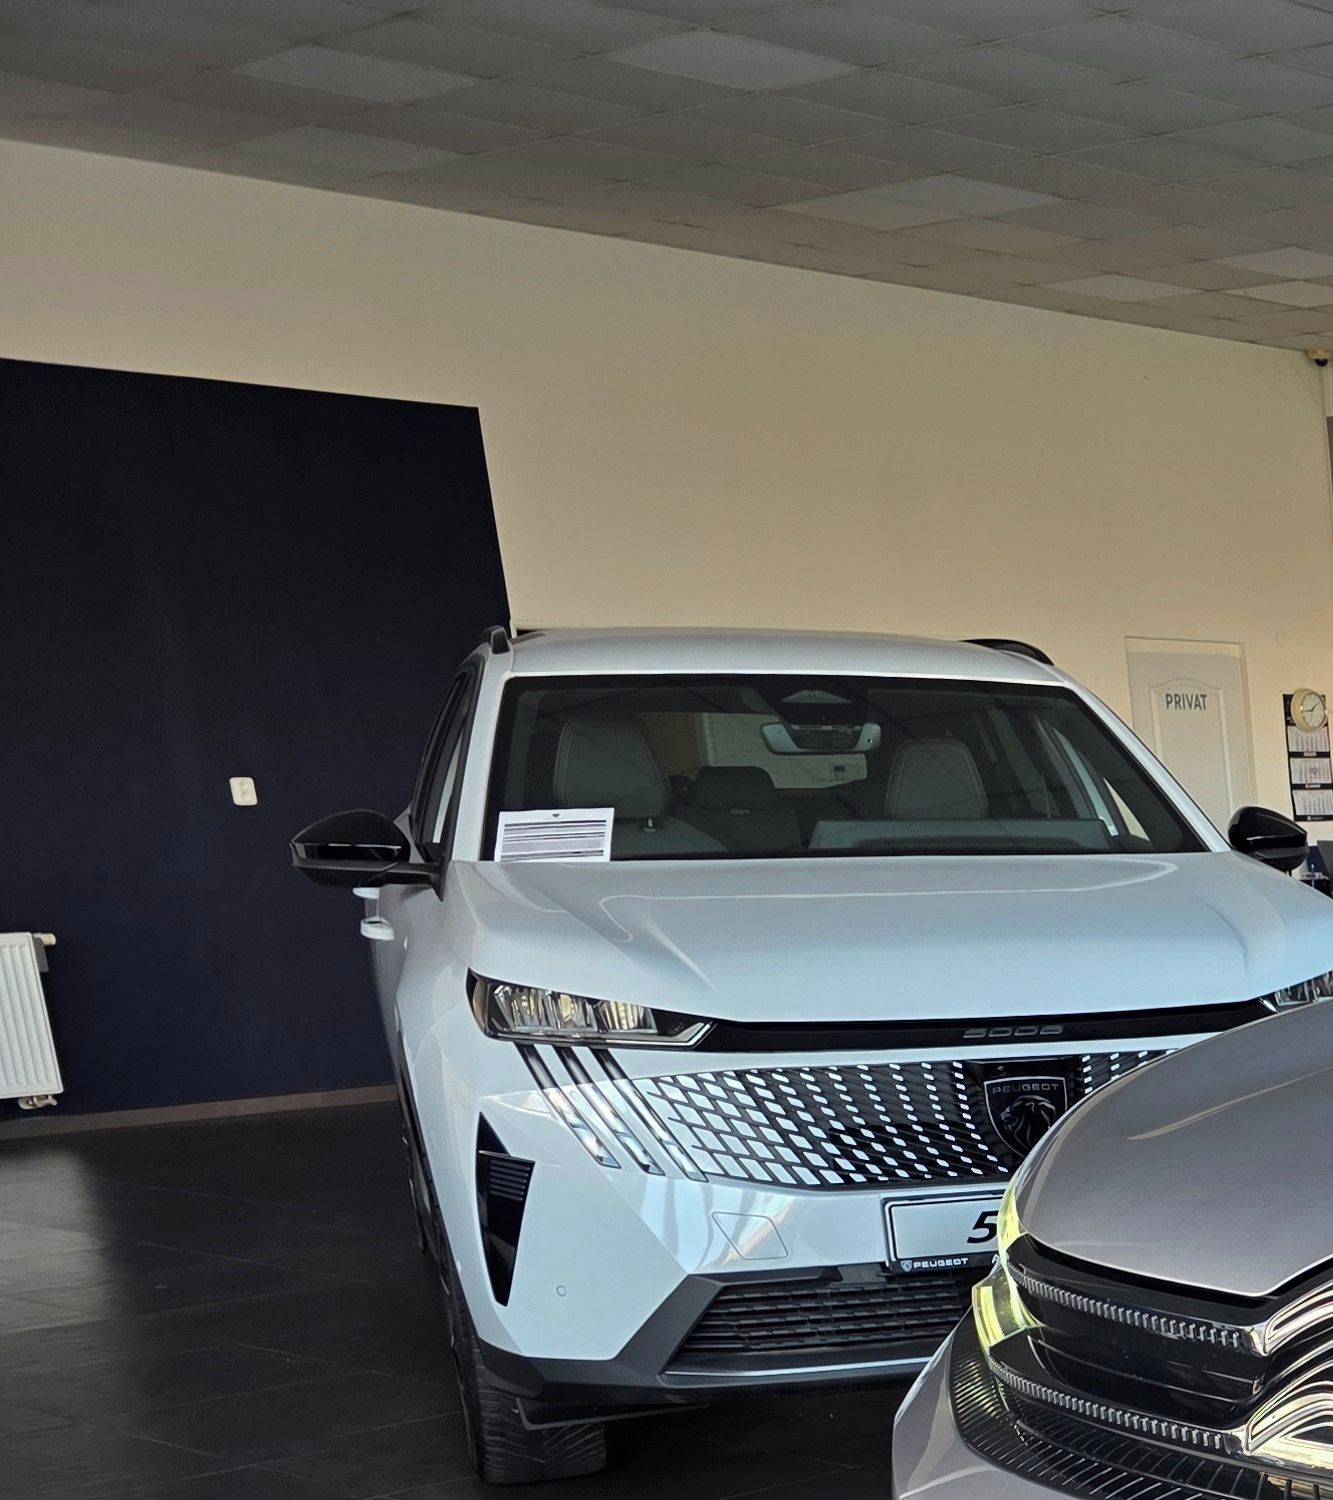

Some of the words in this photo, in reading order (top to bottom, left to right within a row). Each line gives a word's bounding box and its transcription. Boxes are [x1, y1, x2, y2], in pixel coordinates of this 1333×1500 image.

[1166, 693, 1207, 710] PRIVAT
[963, 1025, 1063, 1038] 5008
[992, 1083, 1058, 1094] PEUGEOT
[914, 1257, 968, 1268] PEUGEOT
